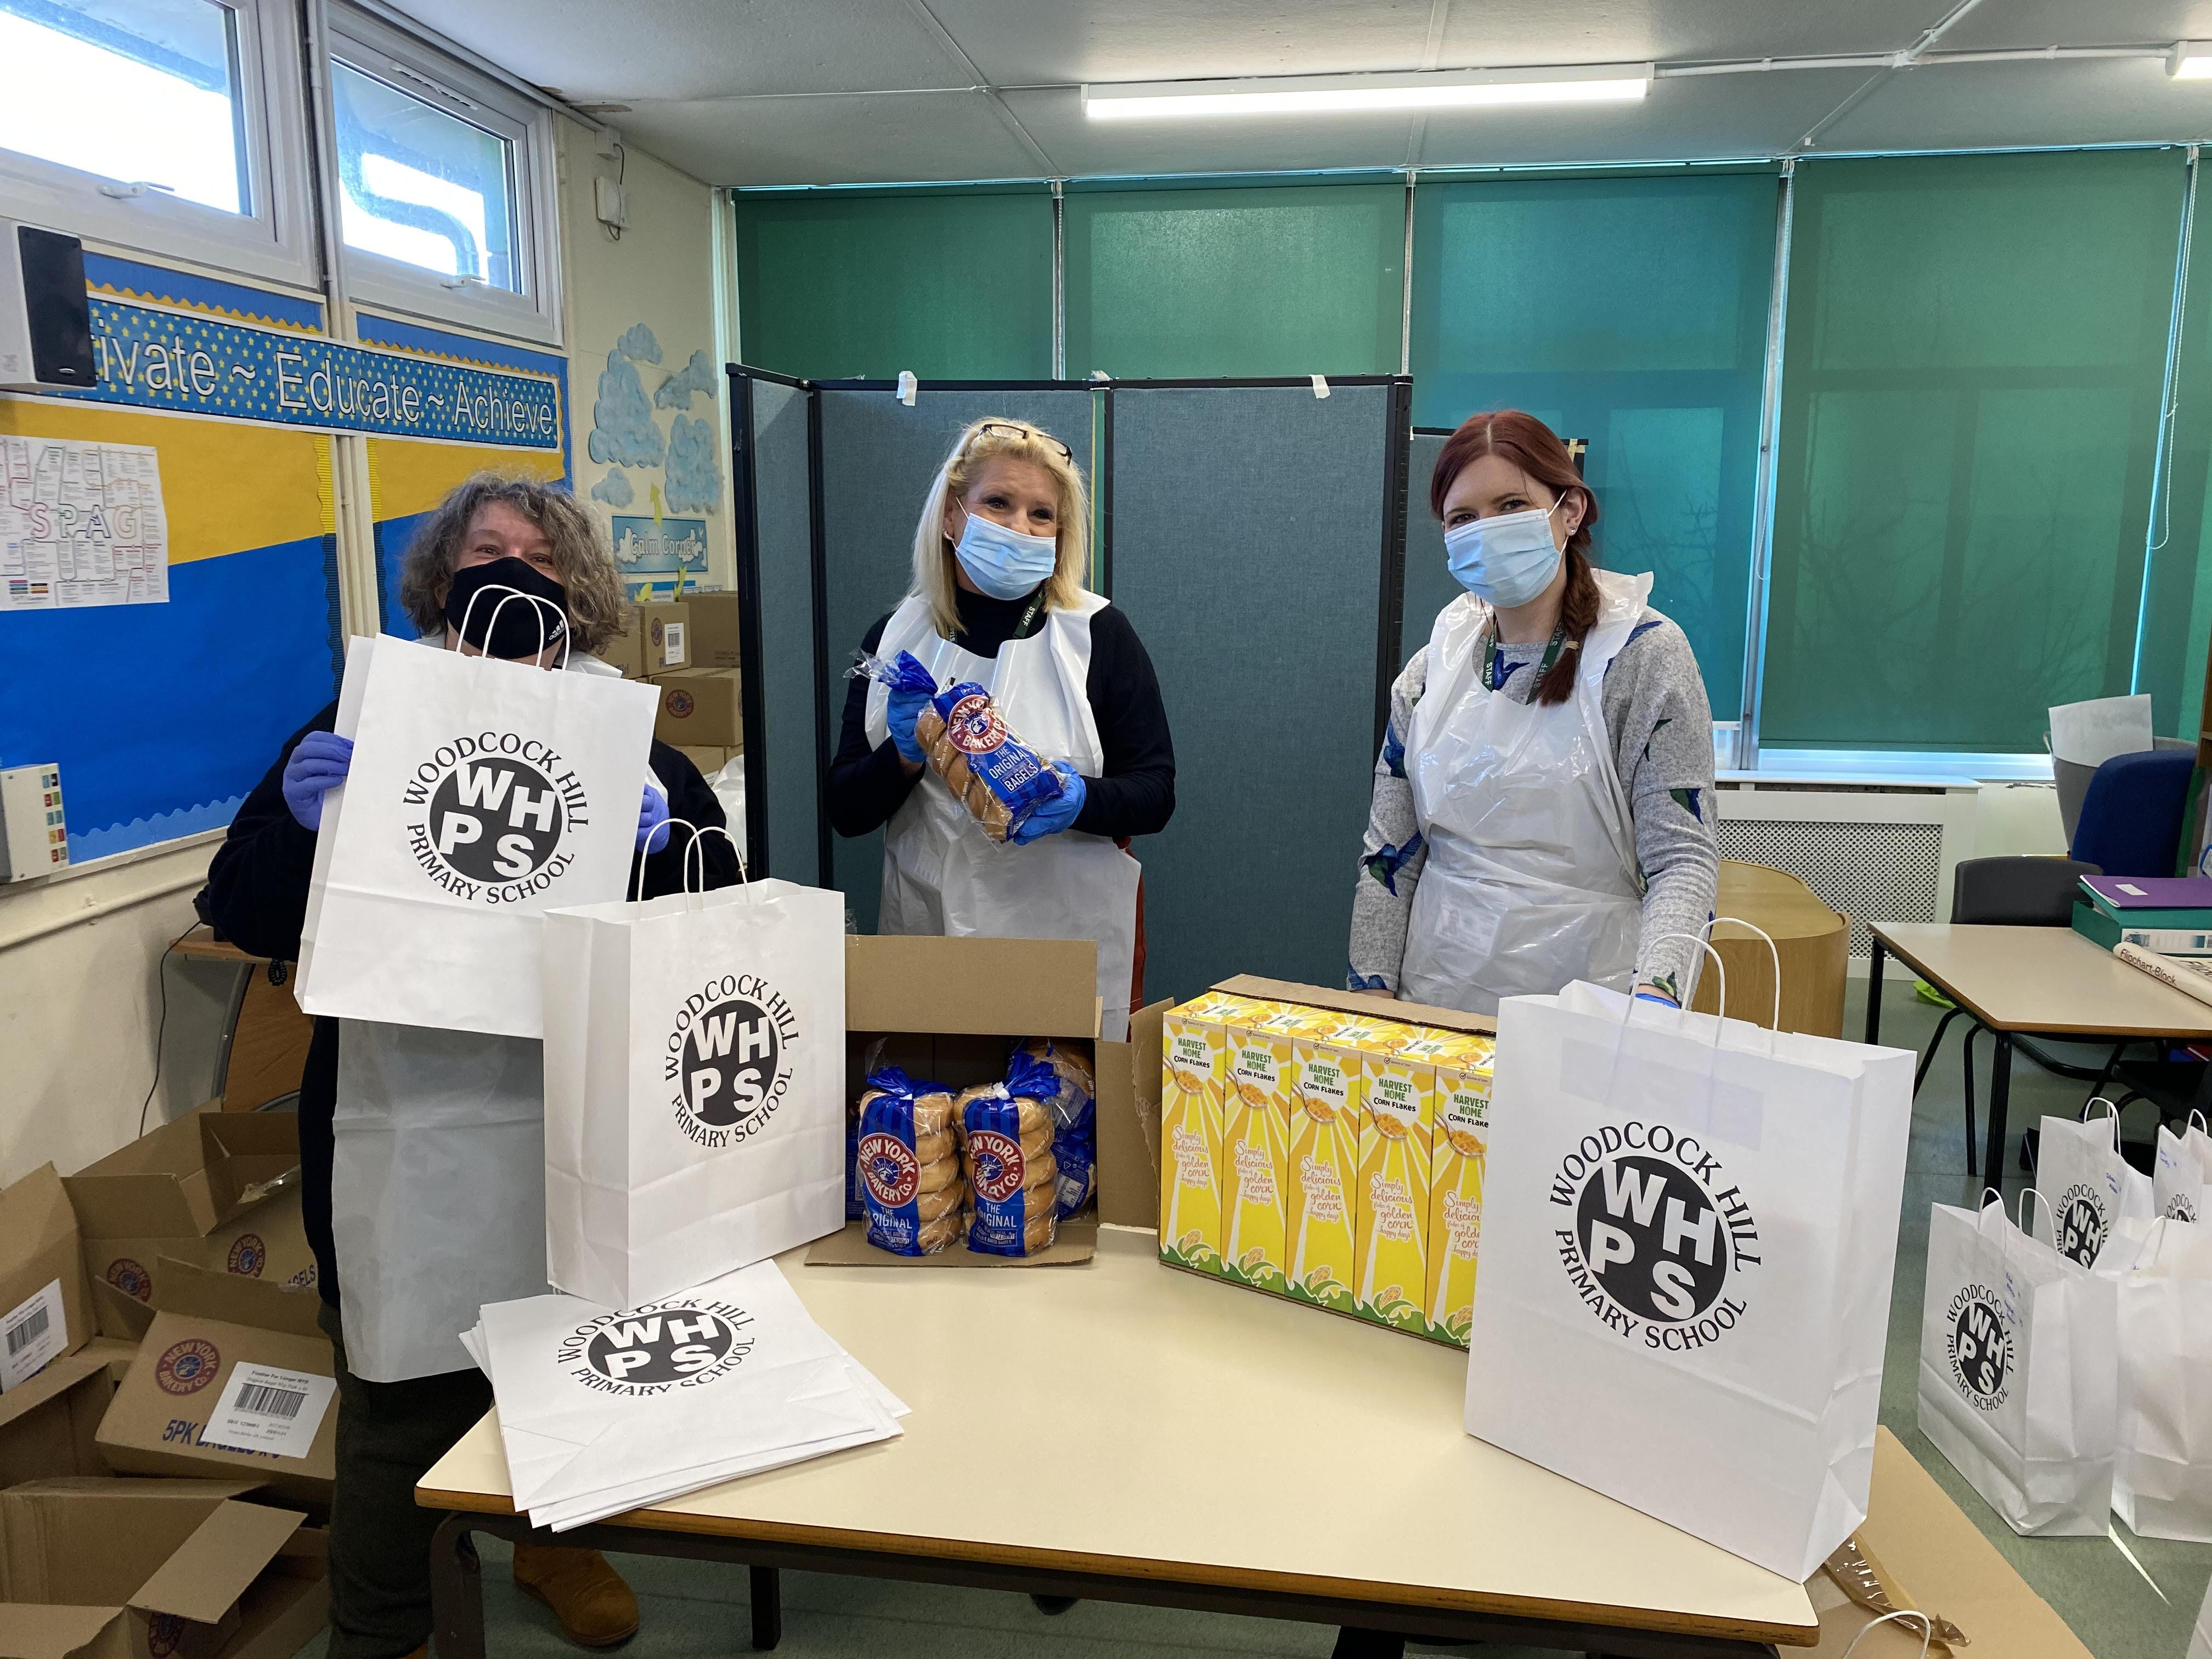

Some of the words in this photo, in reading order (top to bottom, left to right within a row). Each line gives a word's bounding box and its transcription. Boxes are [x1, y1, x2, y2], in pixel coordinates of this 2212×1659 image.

[91, 317, 216, 396] ivate
[276, 351, 420, 422] Educate
[454, 381, 552, 435] Achieve
[30, 502, 137, 539] SPAG
[631, 531, 659, 555] Calm
[662, 534, 696, 555] Corner
[1023, 606, 1036, 627] STAFF
[1485, 662, 1493, 685] STAFF
[951, 705, 970, 735] NEW
[994, 746, 1010, 759] THE
[989, 748, 1030, 779] ORIGINAL
[403, 731, 562, 805] WOODCOCK
[555, 770, 588, 833] HILL
[1004, 760, 1039, 791] BAGELS
[407, 823, 482, 901] PRIMARY
[486, 853, 575, 904] SCHOOL
[2120, 948, 2177, 986] Flipchart-Block
[665, 974, 769, 1082] WOODCOCK
[766, 991, 799, 1050] HILL
[691, 1011, 770, 1064] WH
[1178, 1037, 1206, 1051] HARVEST
[1183, 1047, 1201, 1059] HOME
[1242, 1050, 1271, 1064] HARVEST
[1246, 1060, 1266, 1072] HOME
[1308, 1063, 1340, 1078] HARVEST
[1313, 1074, 1334, 1086] HOME
[690, 1067, 764, 1115] PS
[1379, 1078, 1412, 1093] HARVEST
[1384, 1089, 1406, 1102] HOME
[672, 1092, 730, 1148] PRIMARY
[735, 1068, 793, 1142] SCHOOL
[1454, 1094, 1489, 1109] HARVEST
[1459, 1105, 1482, 1118] HOME
[1173, 1125, 1200, 1145] Simply
[984, 1136, 1020, 1166] YORK
[1173, 1139, 1209, 1153] delicious
[1235, 1140, 1264, 1160] Simply
[860, 1139, 882, 1165] NEW
[884, 1139, 915, 1174] YORK
[1182, 1156, 1208, 1172] golden
[1235, 1158, 1273, 1169] delicious
[1301, 1156, 1332, 1177] Simply
[1188, 1169, 1209, 1177] corn
[1197, 1176, 1207, 1188] days
[1244, 1172, 1273, 1188] golden
[1301, 1171, 1341, 1186] delicious
[867, 1172, 901, 1201] BAKERY
[1372, 1173, 1403, 1194] Simply
[1260, 1193, 1271, 1205] days
[1311, 1189, 1340, 1205] golden
[1317, 1202, 1342, 1210] corn
[1370, 1188, 1413, 1204] delicious
[1444, 1191, 1479, 1214] Simply
[1550, 1121, 1722, 1207] WOODCOCK
[1715, 1185, 1761, 1272] HILL
[2056, 1184, 2106, 1220] WOODCOCK
[881, 1206, 894, 1216] THE
[986, 1203, 1001, 1215] THE
[1327, 1211, 1339, 1222] days
[1380, 1207, 1413, 1223] golden
[1444, 1207, 1480, 1222] delicio
[2164, 1193, 2197, 1223] OODCOCK
[1387, 1220, 1414, 1229] corn
[1455, 1226, 1480, 1243] golde
[1397, 1229, 1410, 1242] days
[1555, 1229, 1639, 1338] PRIMARY
[1645, 1297, 1747, 1351] SCHOOL
[558, 1298, 702, 1364] WOODCOCK
[706, 1301, 755, 1331] HILL
[1946, 1284, 2005, 1328] WOODCOCK
[2004, 1329, 2015, 1375] HILL
[165, 1342, 194, 1363] NEW
[194, 1342, 217, 1369] YORK
[571, 1367, 672, 1397] PRIMARY
[680, 1337, 755, 1387] SCHOOL
[1946, 1333, 1972, 1398] PRIMARY
[1973, 1387, 2009, 1411] SCHOOL
[162, 1419, 199, 1444] 5PK
